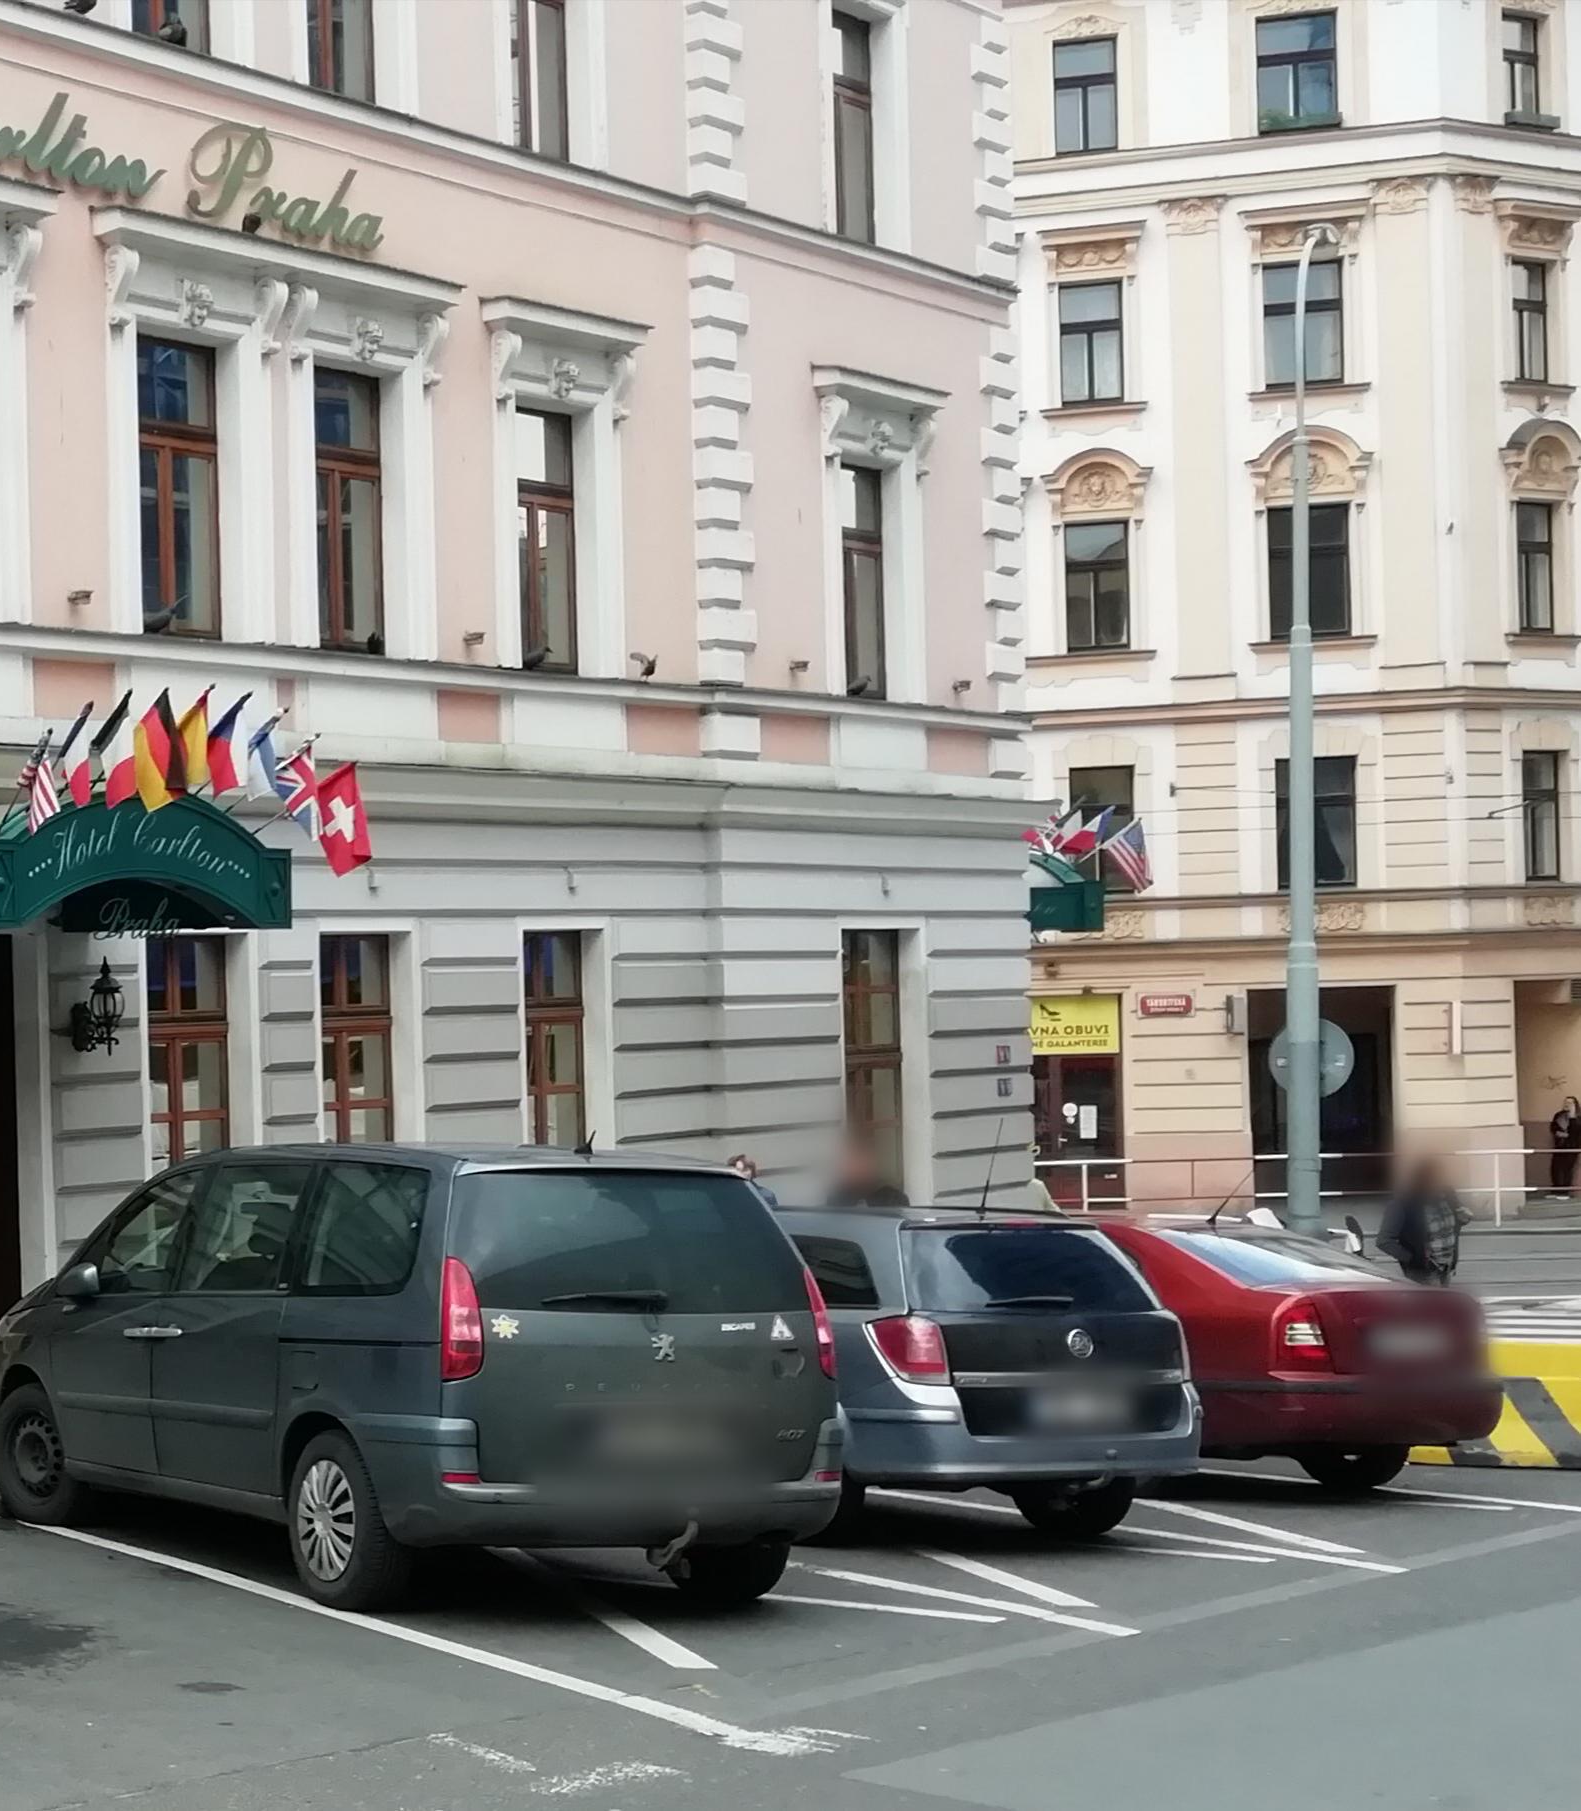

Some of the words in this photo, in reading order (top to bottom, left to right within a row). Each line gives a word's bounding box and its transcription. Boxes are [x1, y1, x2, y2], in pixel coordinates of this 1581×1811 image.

[187, 124, 384, 251] Praha
[54, 811, 121, 880] Hotel
[130, 811, 229, 875] Carlton
[92, 897, 180, 940] Praha
[1064, 1024, 1109, 1035] OBUVI
